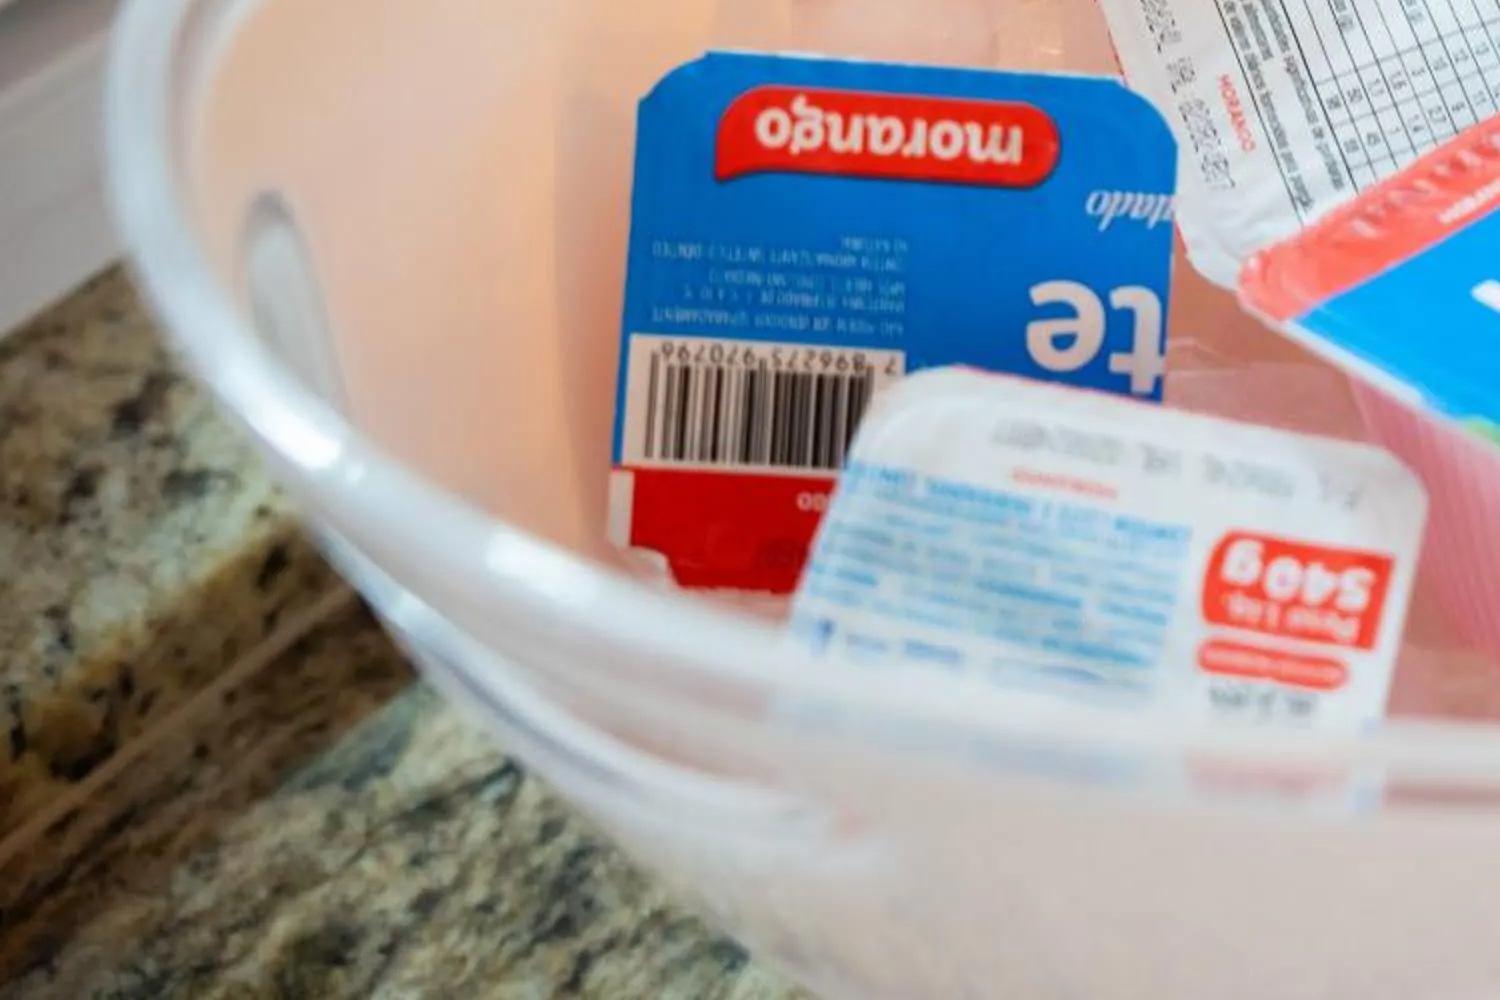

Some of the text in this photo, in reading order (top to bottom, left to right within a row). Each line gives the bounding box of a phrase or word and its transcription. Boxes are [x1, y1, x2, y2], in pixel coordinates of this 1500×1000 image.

[755, 96, 1024, 165] morango
[1213, 72, 1258, 155] MORANGO
[659, 341, 895, 373] 7 896275 970796
[1025, 280, 1167, 394] te
